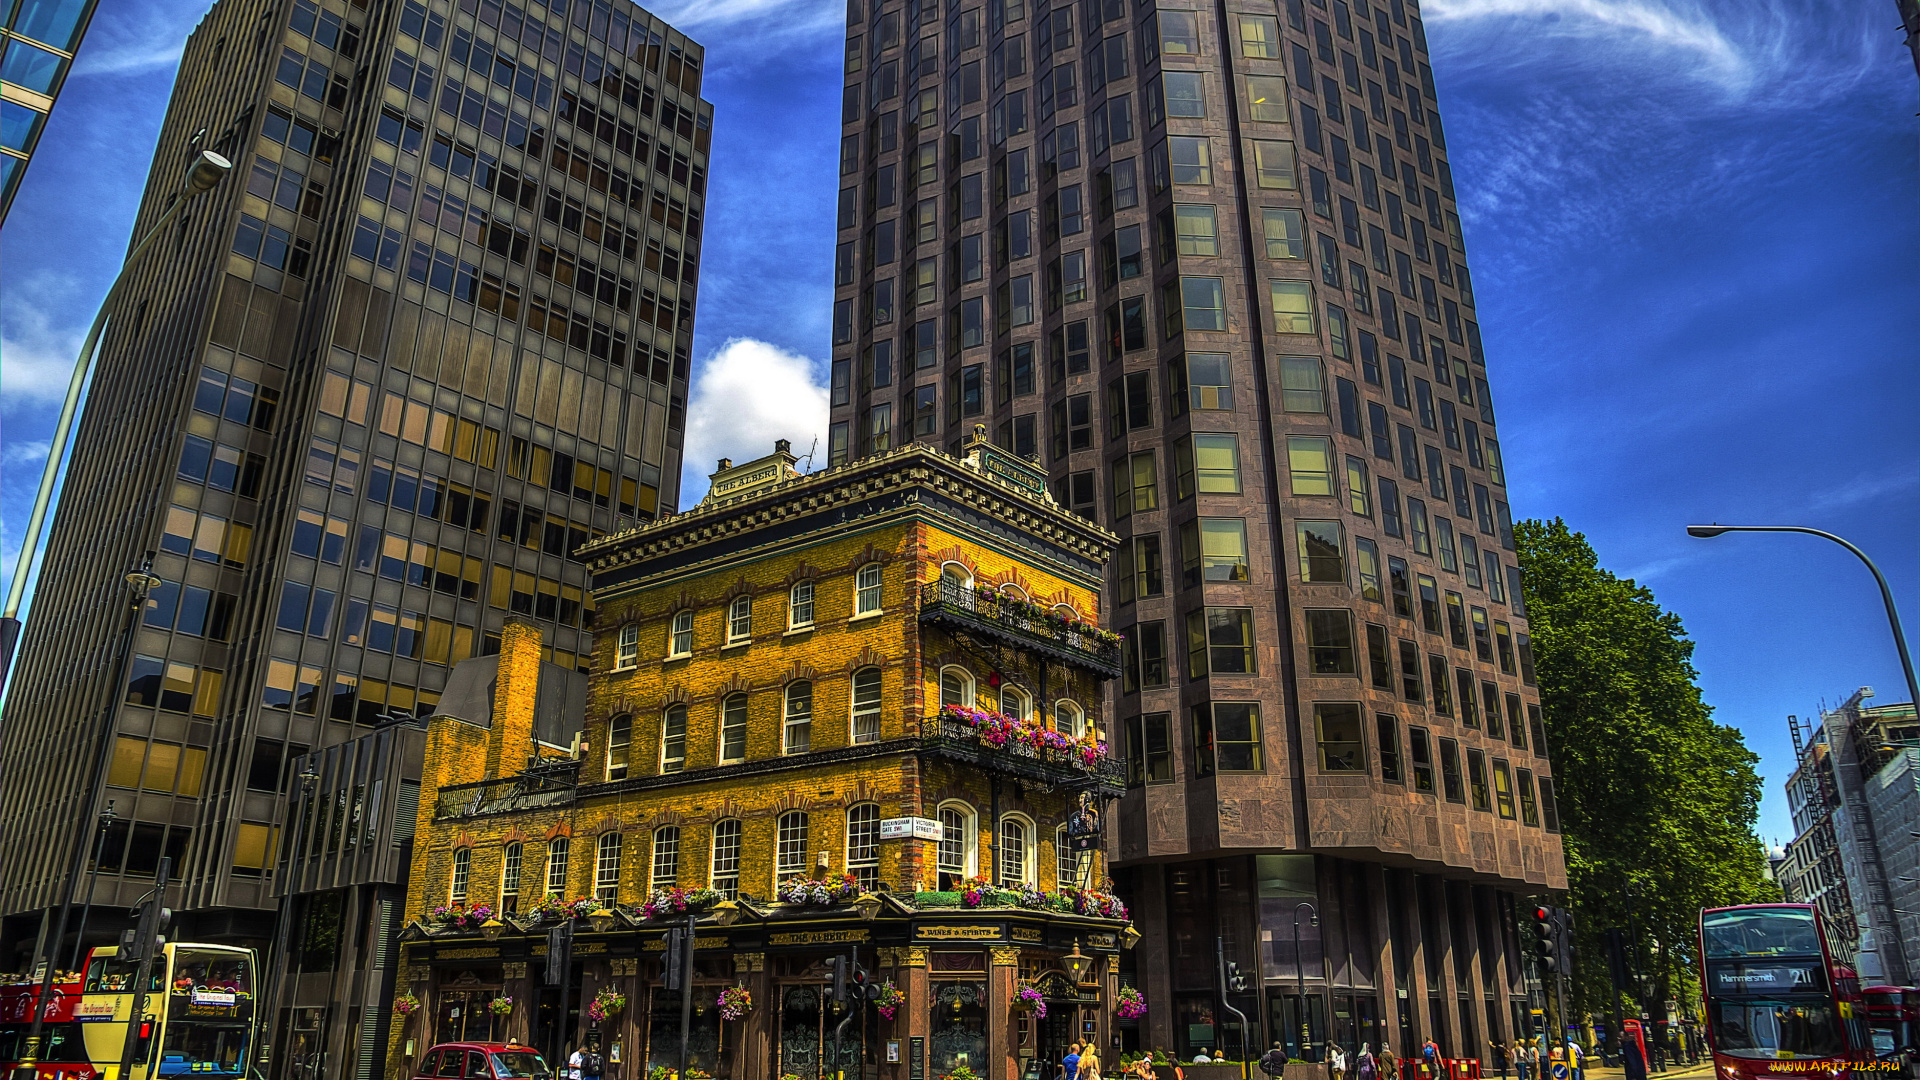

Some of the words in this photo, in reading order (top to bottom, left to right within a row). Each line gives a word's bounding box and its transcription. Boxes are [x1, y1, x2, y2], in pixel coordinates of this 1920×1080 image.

[717, 481, 736, 493] THE
[738, 468, 777, 487] ALBERT
[882, 819, 910, 827] BUCKINGHAM
[915, 819, 936, 828] VICTORIA
[915, 825, 932, 833] STREET
[790, 934, 808, 943] THE
[812, 931, 848, 942] ALBERT
[1719, 973, 1776, 983] Hammersmith
[1790, 969, 1812, 984] 211
[207, 993, 224, 1001] Original
